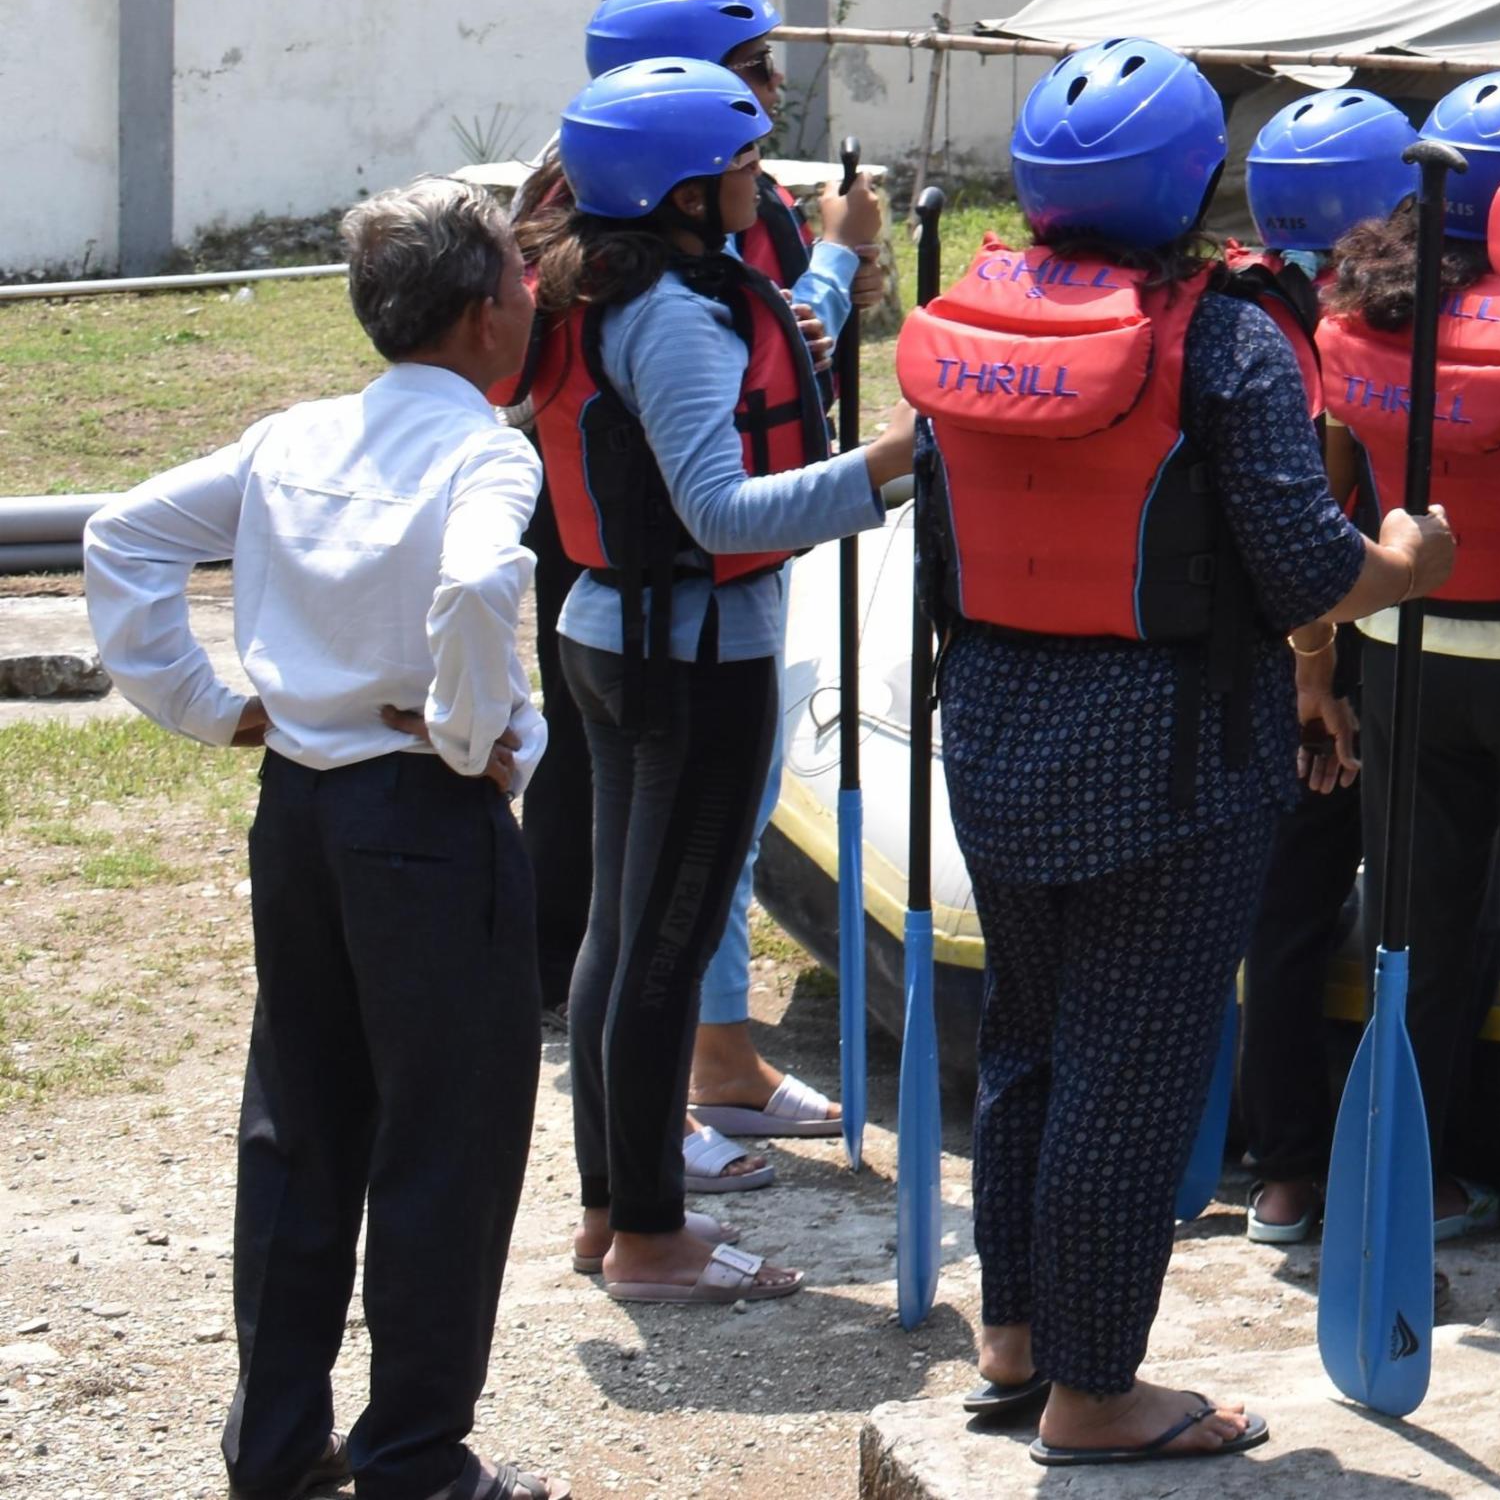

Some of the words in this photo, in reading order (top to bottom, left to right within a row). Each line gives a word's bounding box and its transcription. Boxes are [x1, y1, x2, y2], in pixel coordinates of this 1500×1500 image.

[1444, 200, 1475, 217] XIS
[977, 257, 1119, 289] CHILL
[1025, 285, 1046, 299] &
[936, 357, 1079, 398] THRILL
[1343, 372, 1473, 425] THRLL
